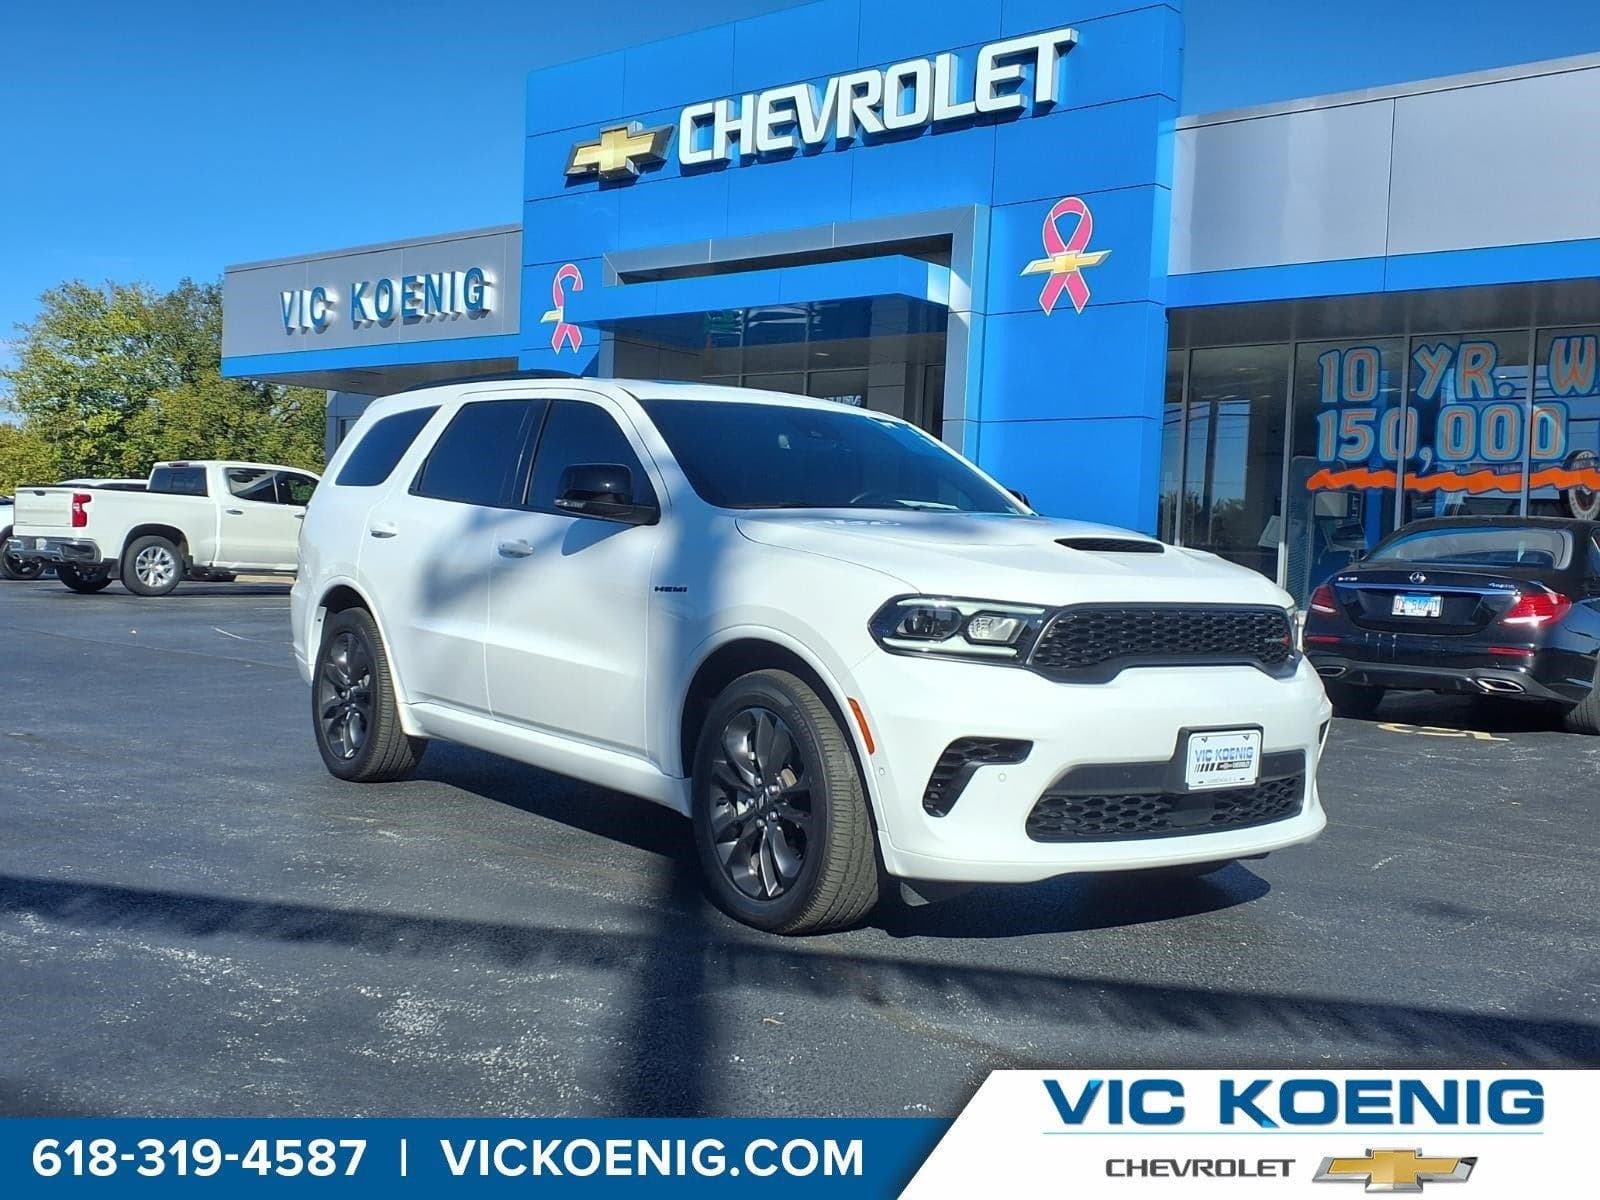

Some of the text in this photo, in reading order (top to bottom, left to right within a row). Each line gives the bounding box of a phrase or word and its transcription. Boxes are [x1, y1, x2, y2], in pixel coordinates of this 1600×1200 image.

[678, 28, 1078, 167] CHEVROLET
[280, 267, 492, 333] VIC KOENIG
[1317, 345, 1382, 403] 10
[1411, 339, 1515, 400] YR.
[1316, 401, 1570, 473] 150,000
[1195, 746, 1254, 763] VIC KOENIG
